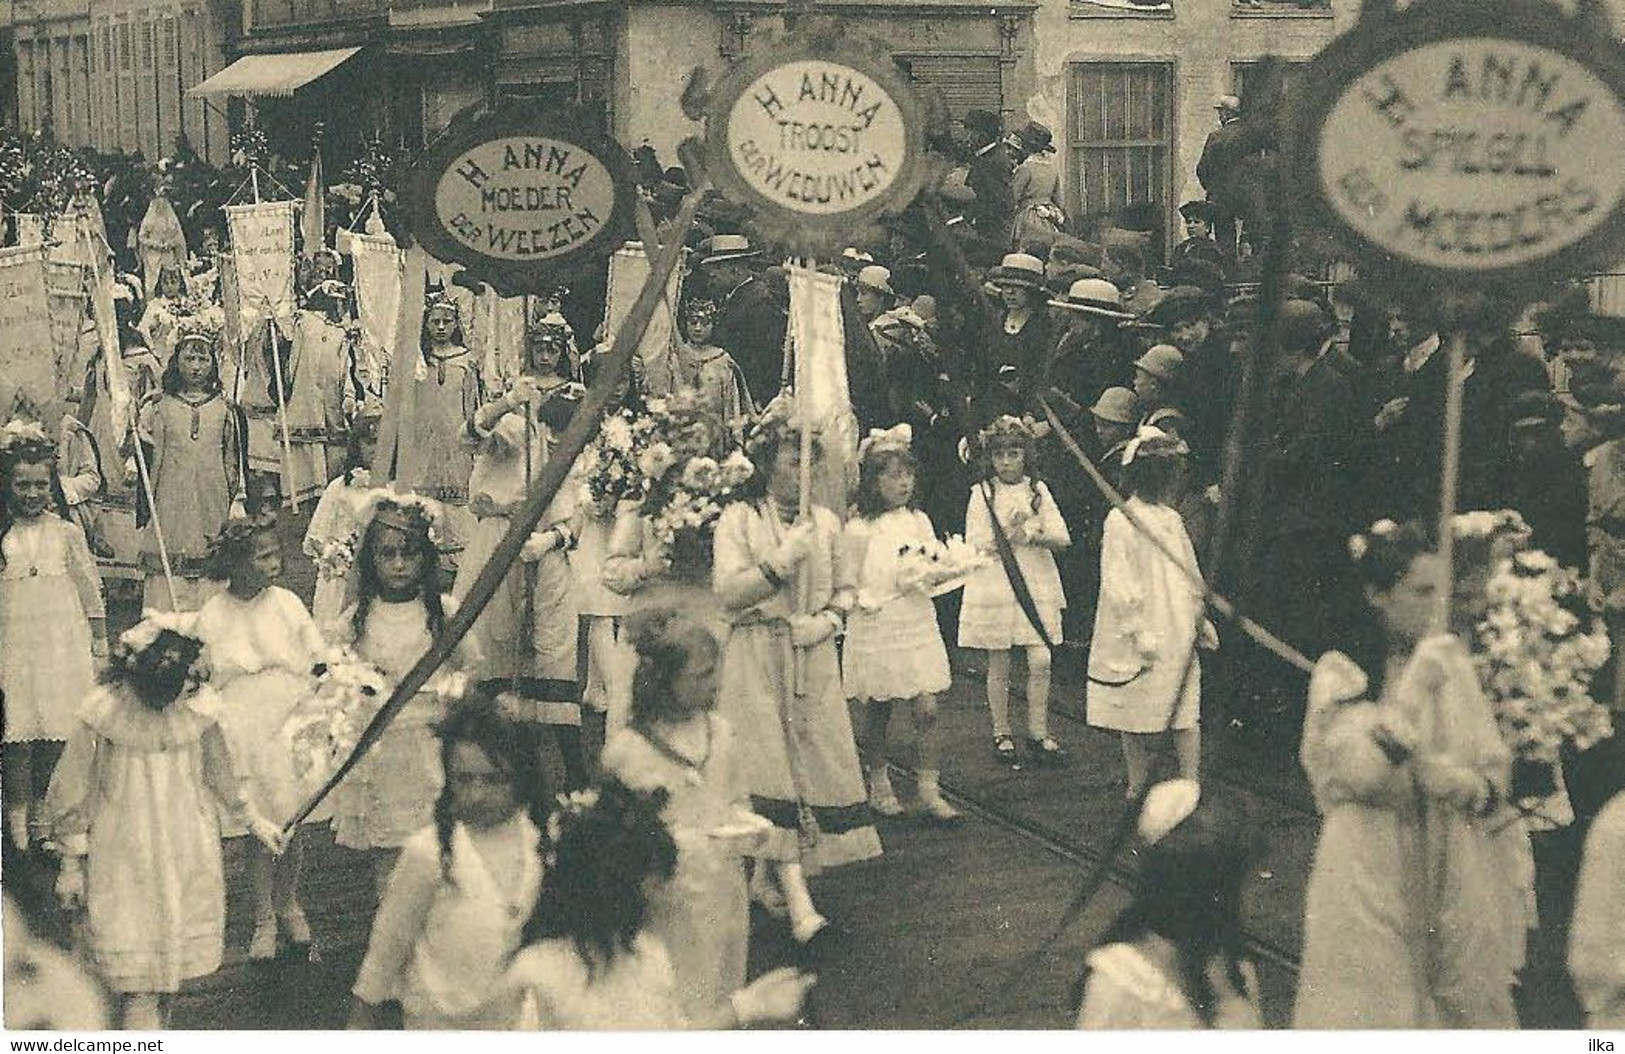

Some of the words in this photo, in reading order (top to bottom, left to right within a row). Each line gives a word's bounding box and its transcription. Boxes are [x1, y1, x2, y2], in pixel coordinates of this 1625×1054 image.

[799, 71, 882, 128] ANNA
[1442, 54, 1591, 139] ANNA
[777, 120, 864, 154] TROOST
[503, 143, 588, 188] ANNA
[765, 153, 888, 204] WEDUWEN
[481, 186, 574, 213] MOEDER
[487, 206, 600, 255] WEEZEN
